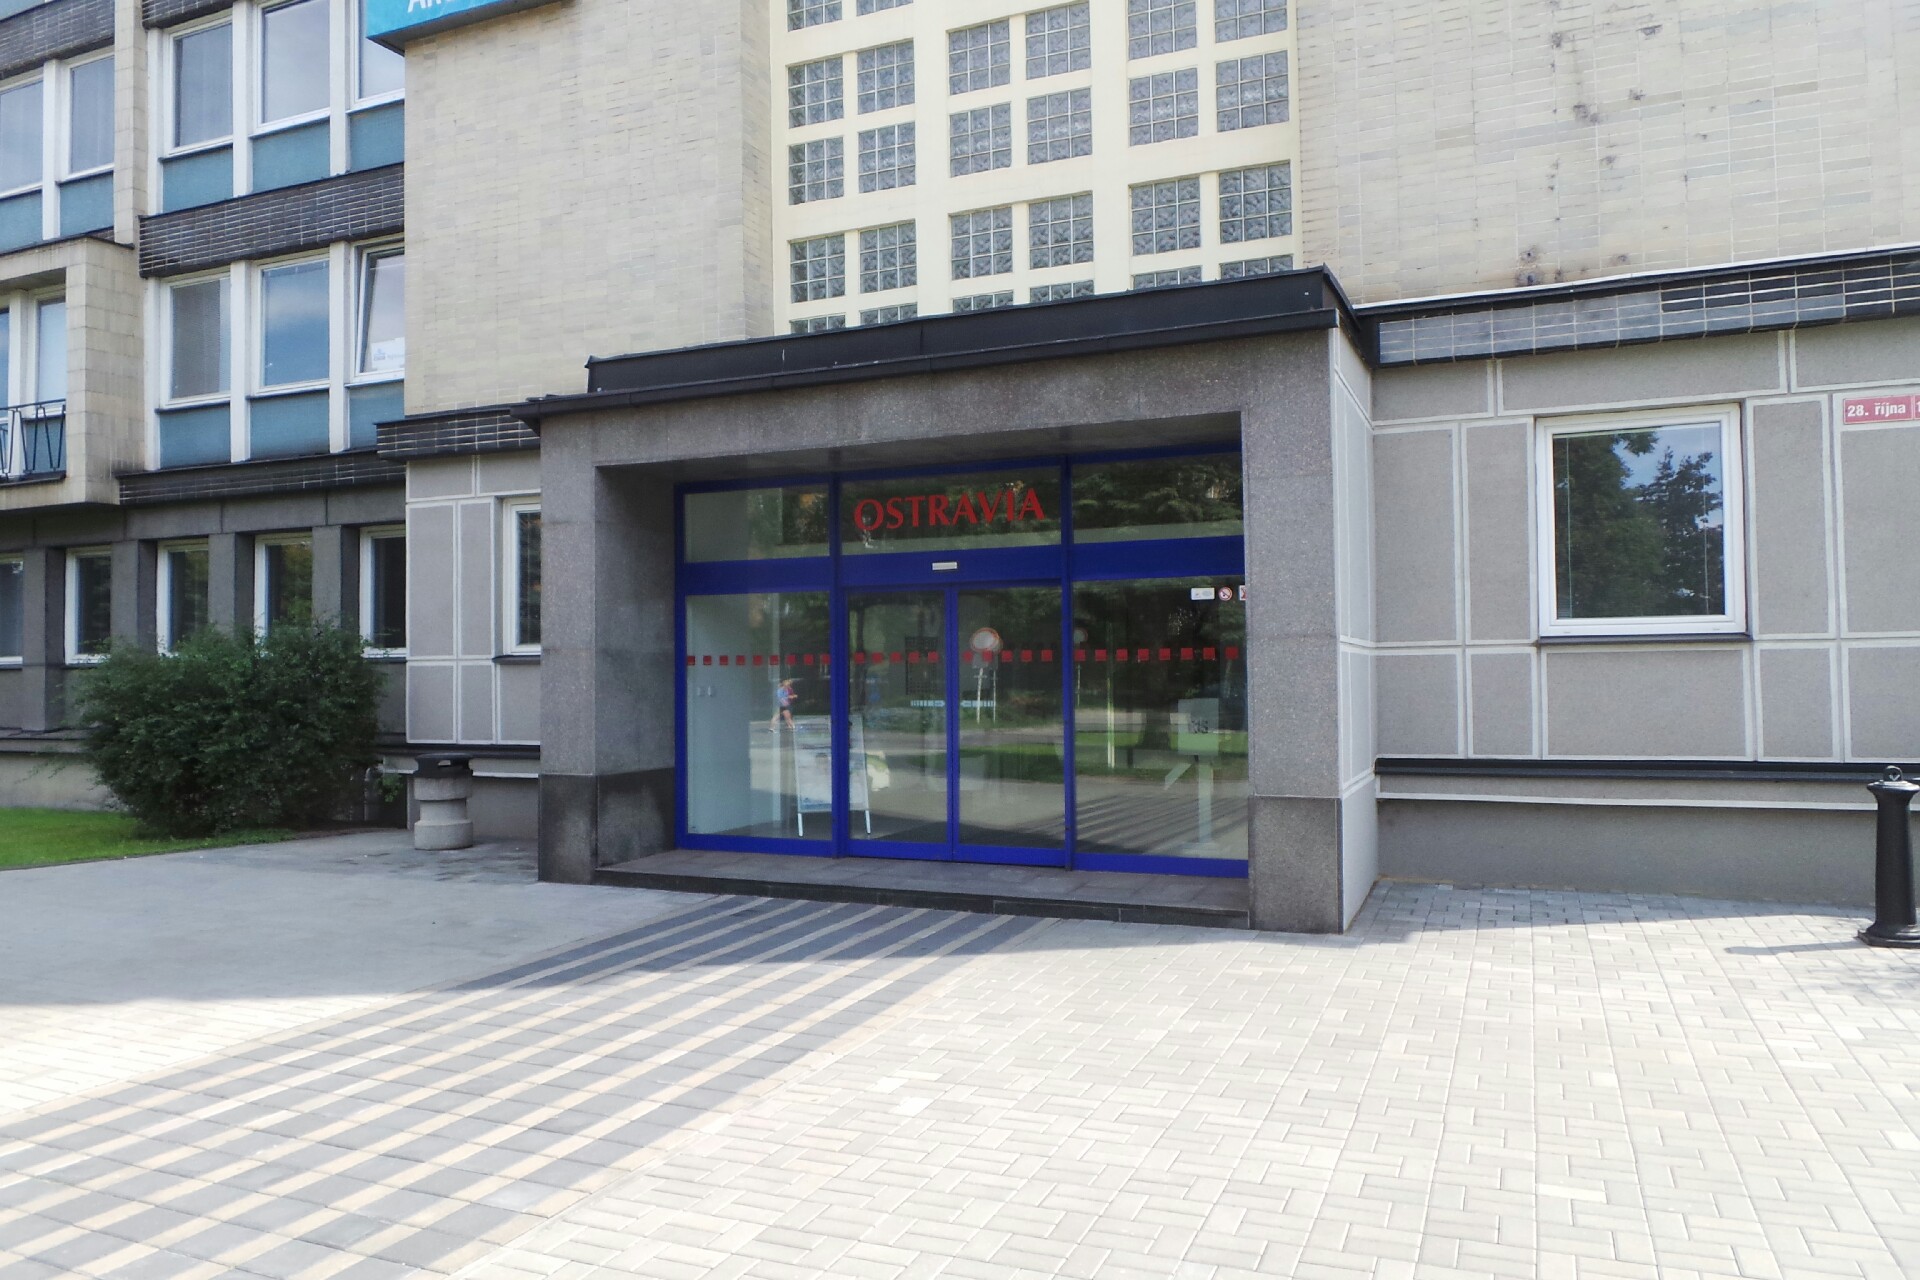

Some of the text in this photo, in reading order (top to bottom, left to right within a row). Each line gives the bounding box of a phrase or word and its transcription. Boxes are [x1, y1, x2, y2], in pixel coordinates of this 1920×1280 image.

[1847, 401, 1906, 418] 28. října
[853, 488, 1046, 532] OSTRAVIA
